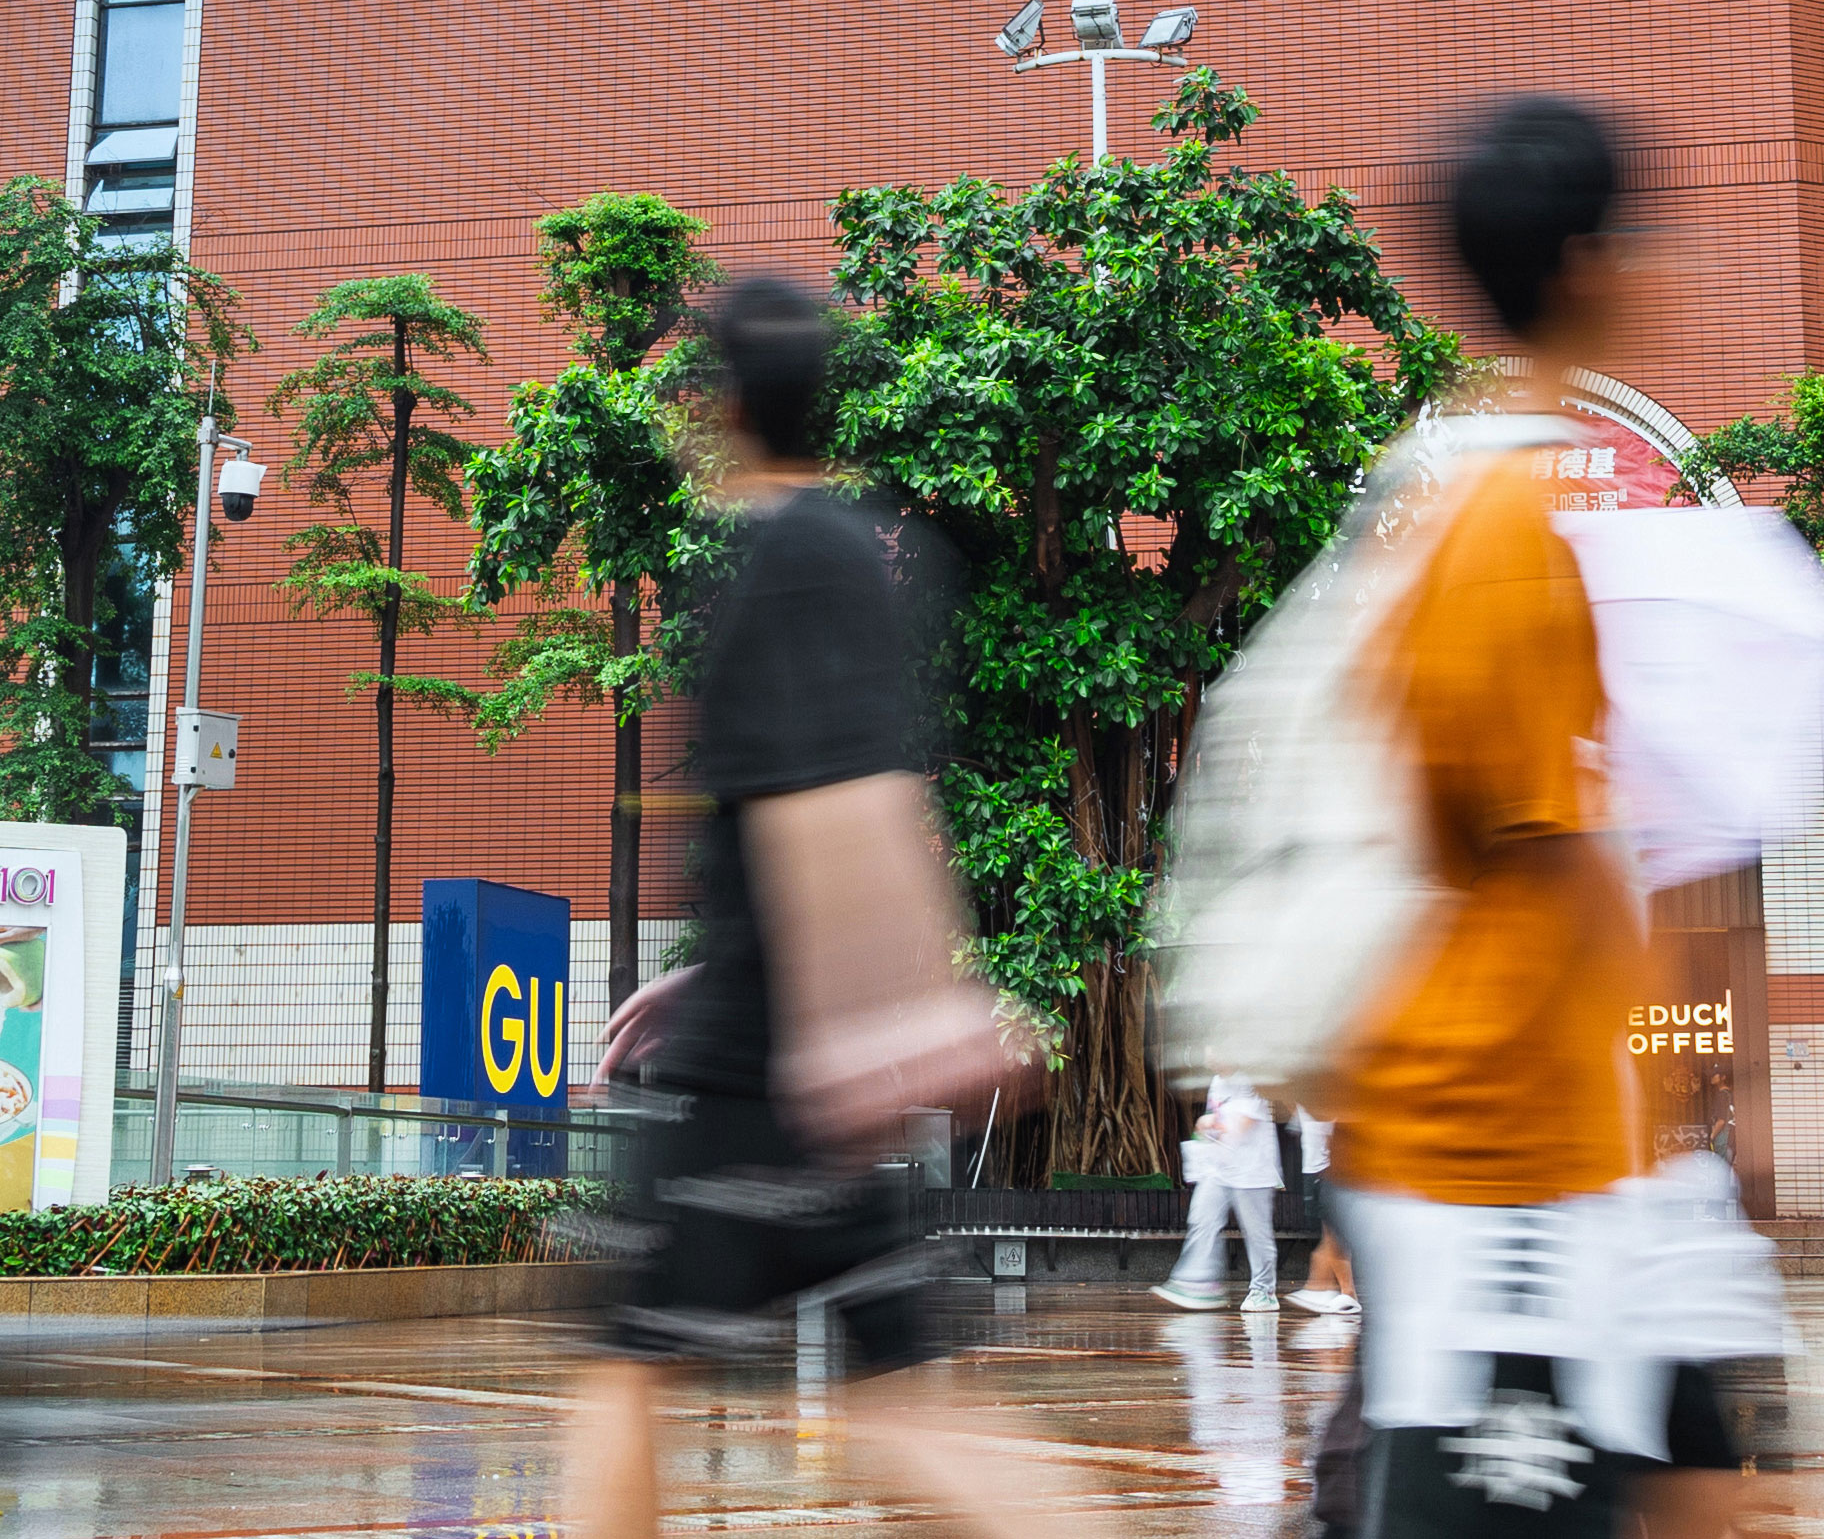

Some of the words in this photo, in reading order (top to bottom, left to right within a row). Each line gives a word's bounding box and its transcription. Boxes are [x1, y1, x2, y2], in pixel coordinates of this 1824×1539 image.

[1530, 446, 1617, 479] 肯德基
[481, 964, 563, 1097] GU
